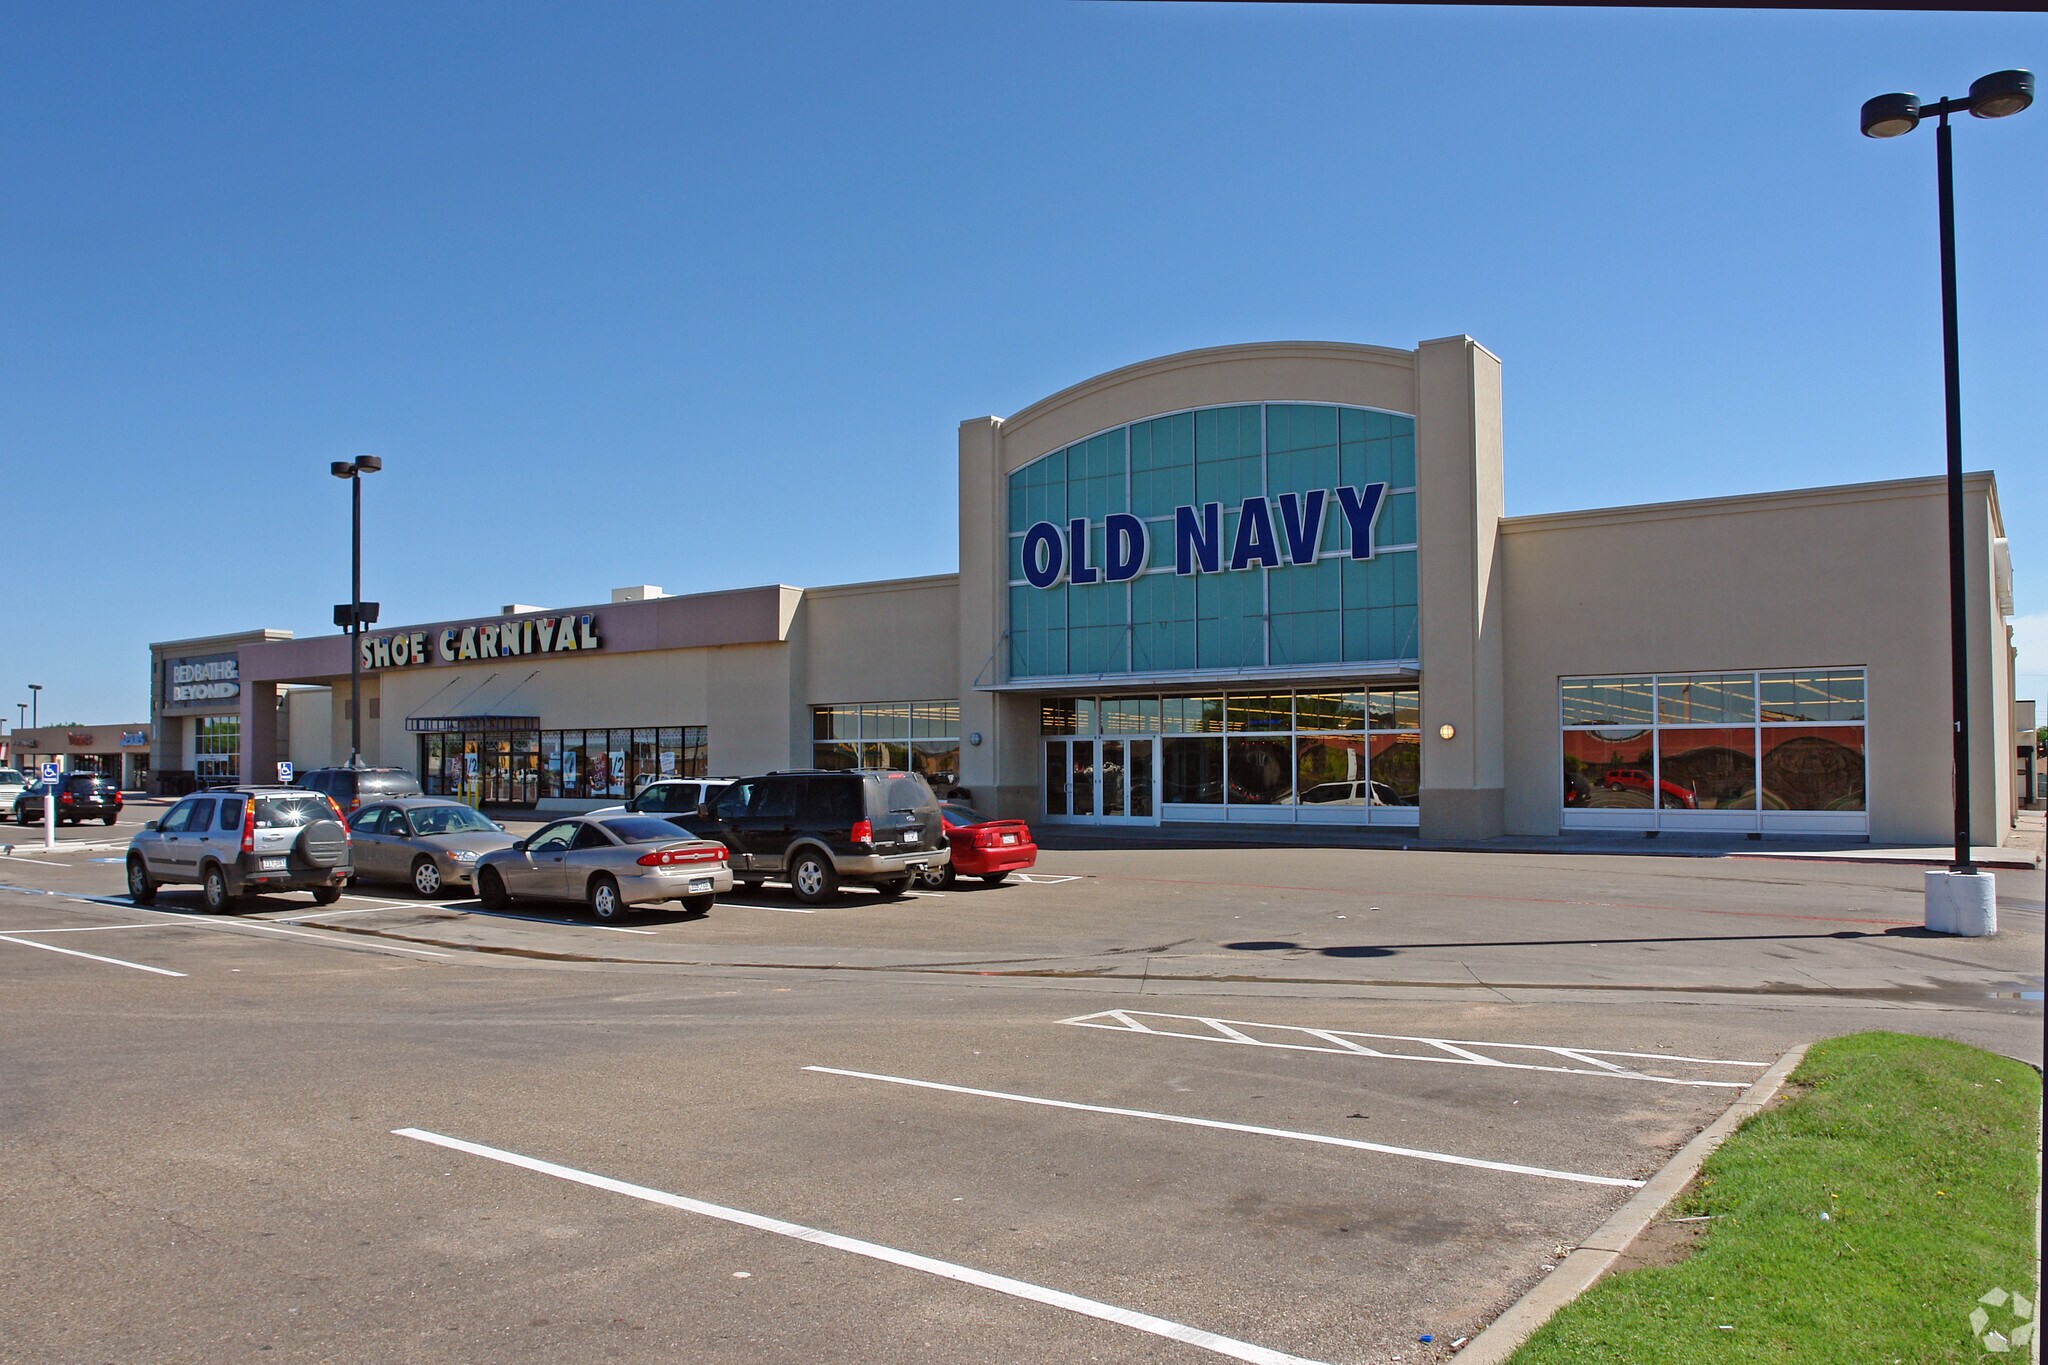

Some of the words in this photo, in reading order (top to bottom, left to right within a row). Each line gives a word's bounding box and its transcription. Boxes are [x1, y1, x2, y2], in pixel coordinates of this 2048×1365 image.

[1021, 513, 1149, 589] OLD
[1175, 482, 1389, 576] NAVY
[361, 632, 426, 669] SHOE
[439, 613, 598, 662] CARNIVAL
[174, 665, 194, 683] BED
[195, 662, 225, 681] BATH
[225, 660, 238, 678] &
[174, 683, 239, 701] BEYOND
[1954, 720, 1961, 733] 1
[609, 757, 624, 775] 1/2
